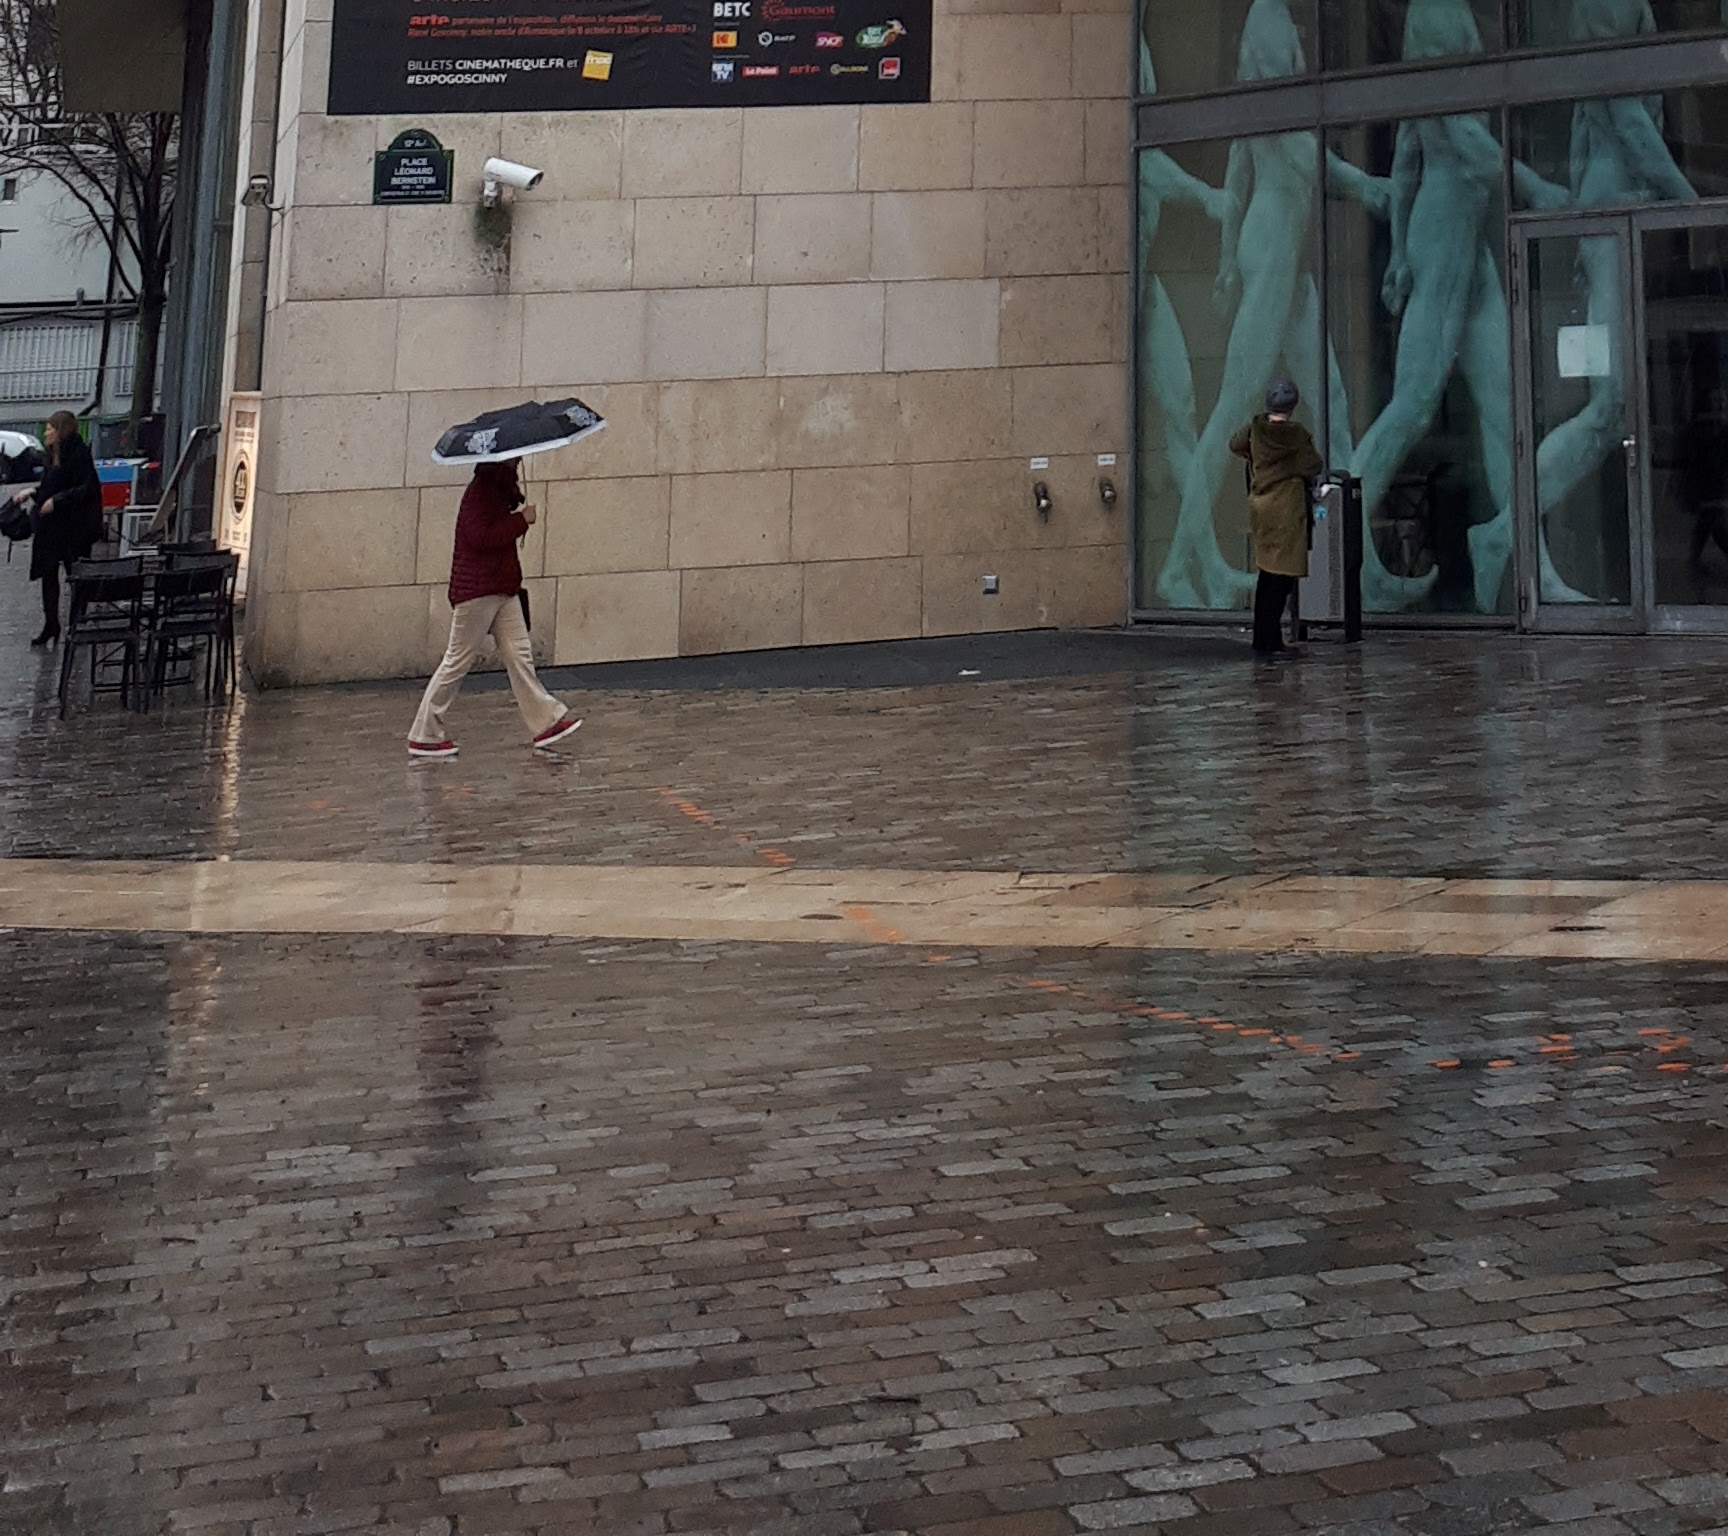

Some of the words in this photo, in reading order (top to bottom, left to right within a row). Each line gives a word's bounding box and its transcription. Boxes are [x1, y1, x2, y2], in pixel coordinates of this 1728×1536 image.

[713, 2, 751, 18] BETC
[768, 3, 836, 16] Gaumont
[409, 14, 450, 26] arte
[407, 59, 453, 72] BILLETS
[454, 57, 564, 71] CINEMATHEQUE.FR
[788, 64, 821, 76] arte
[406, 72, 508, 85] #EXPOGOSCINNY
[400, 158, 428, 166] PLACE
